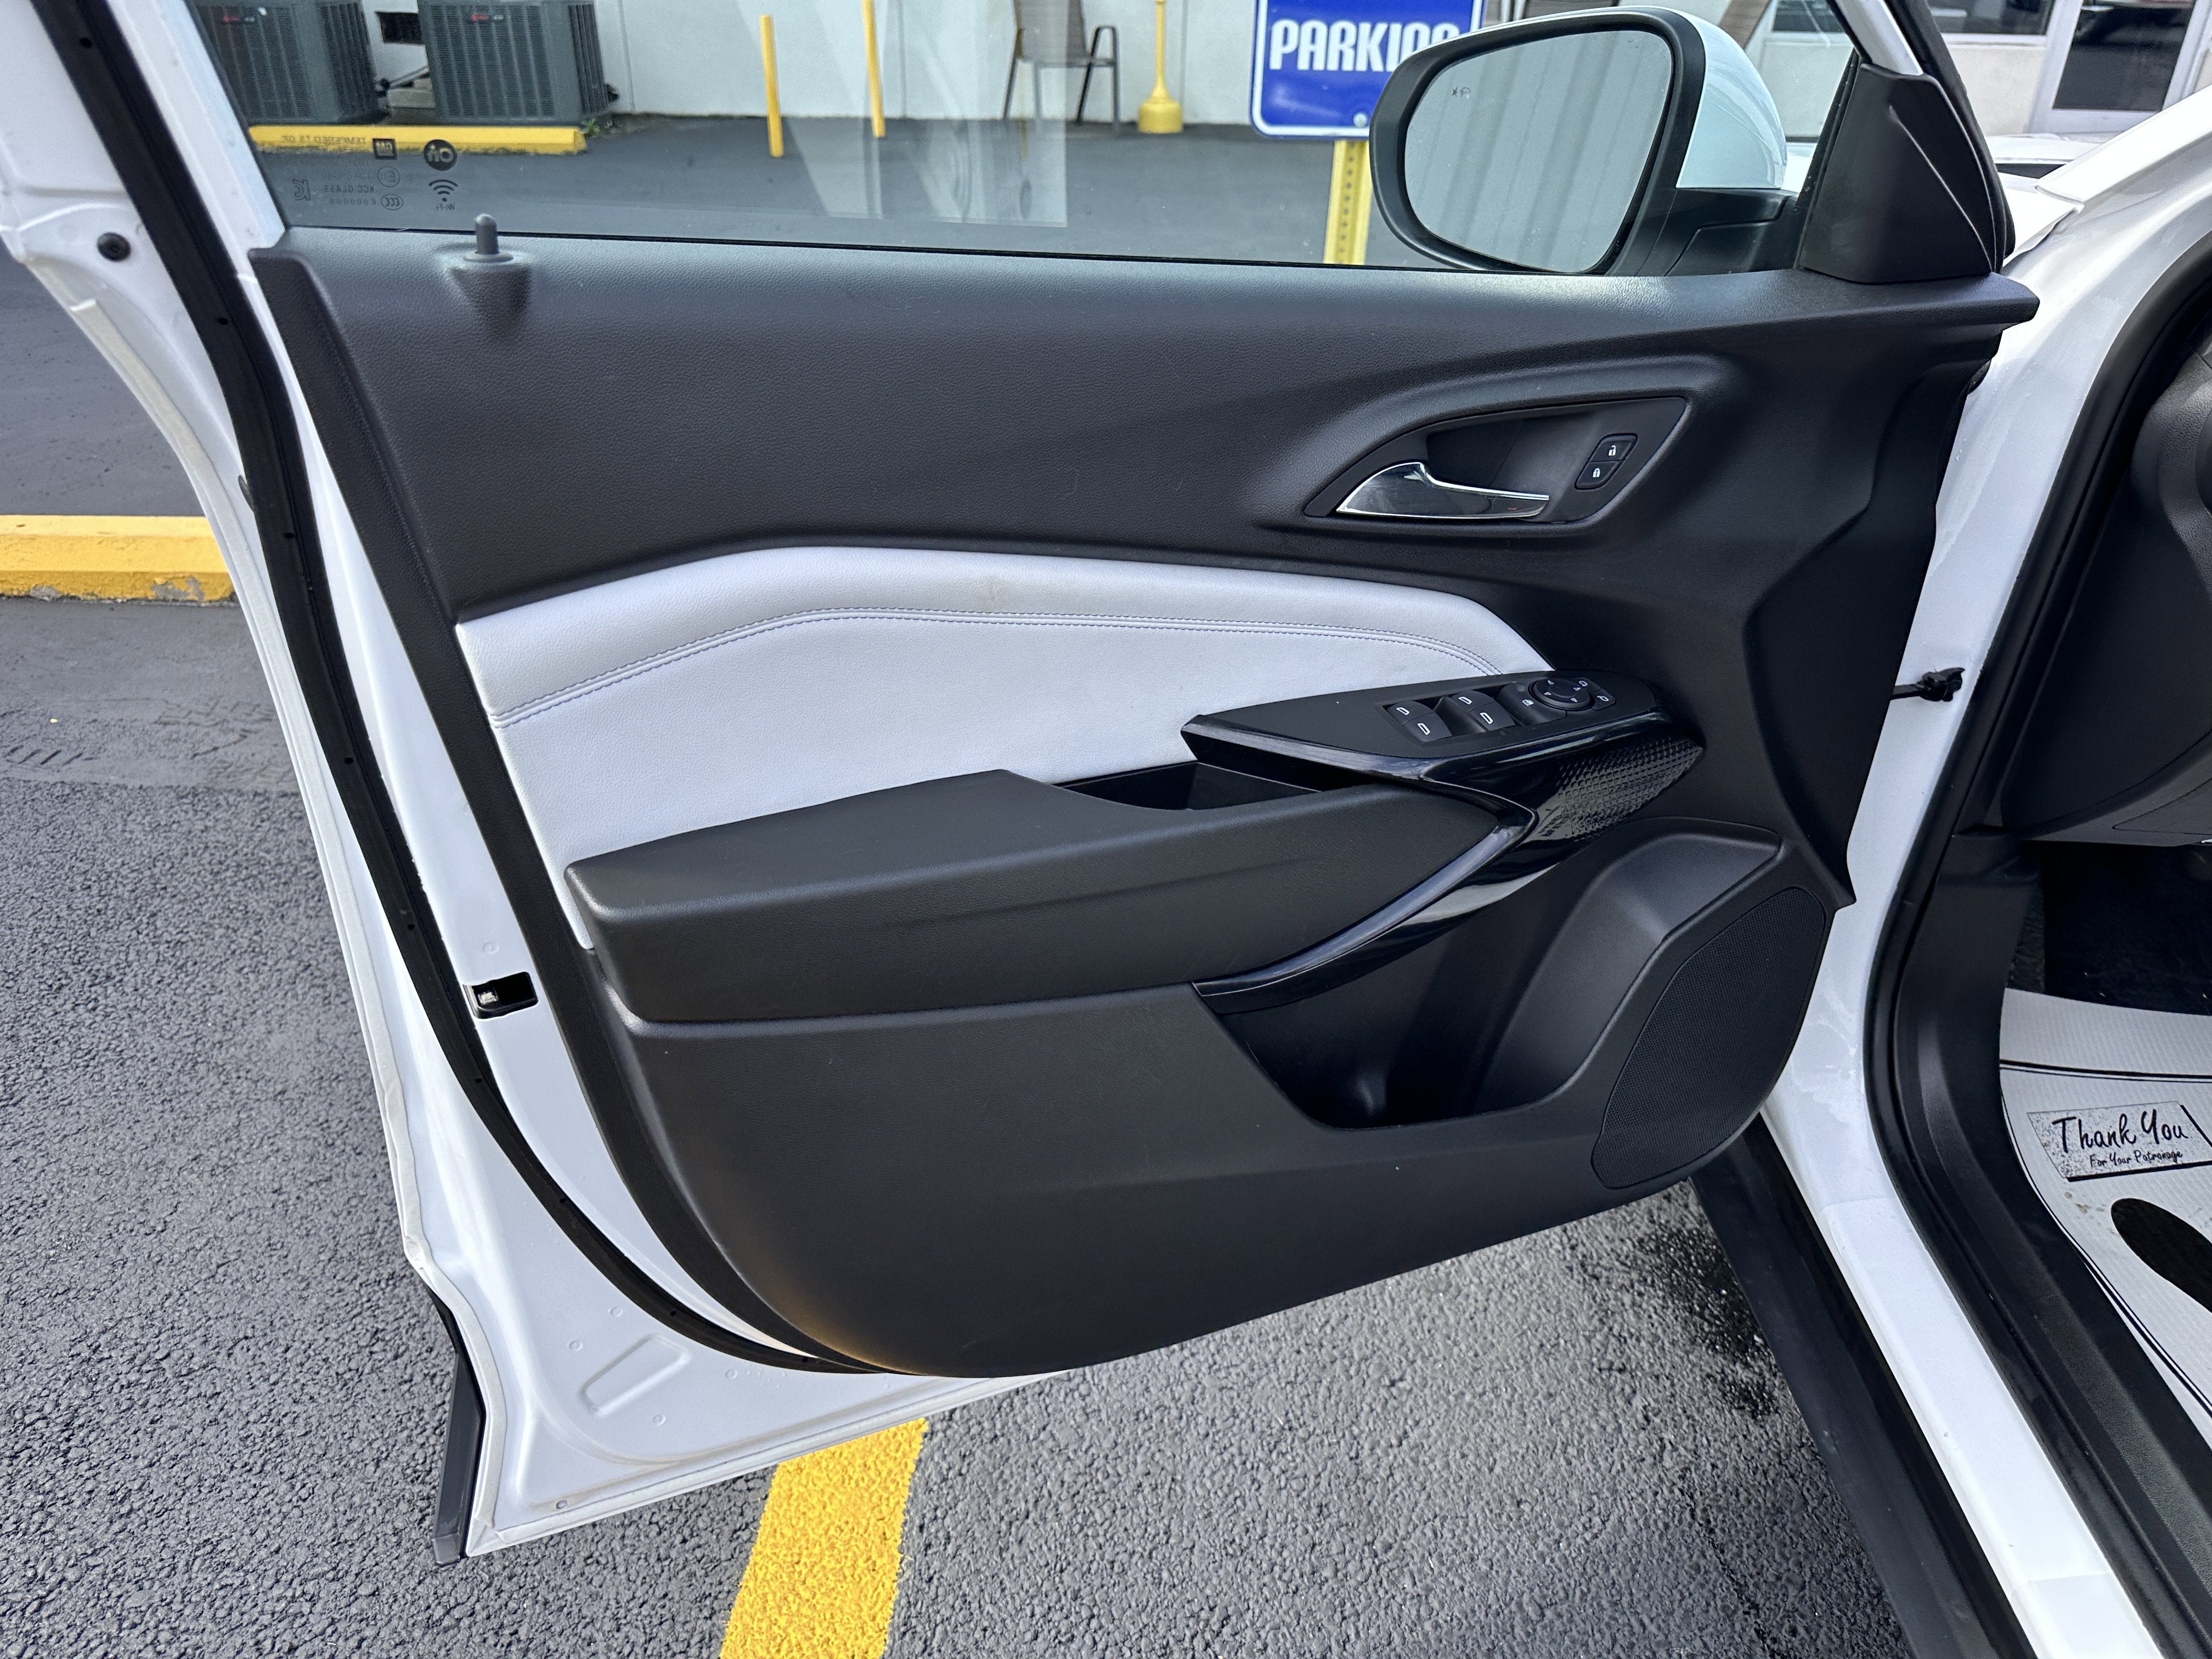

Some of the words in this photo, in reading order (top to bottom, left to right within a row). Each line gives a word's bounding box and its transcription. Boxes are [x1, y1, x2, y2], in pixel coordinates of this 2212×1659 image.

[2052, 1113, 2136, 1153] Thank
[2141, 1108, 2188, 1145] You
[2090, 1155, 2107, 1168] For
[2109, 1152, 2132, 1166] Your
[2133, 1149, 2183, 1164] Patronage
